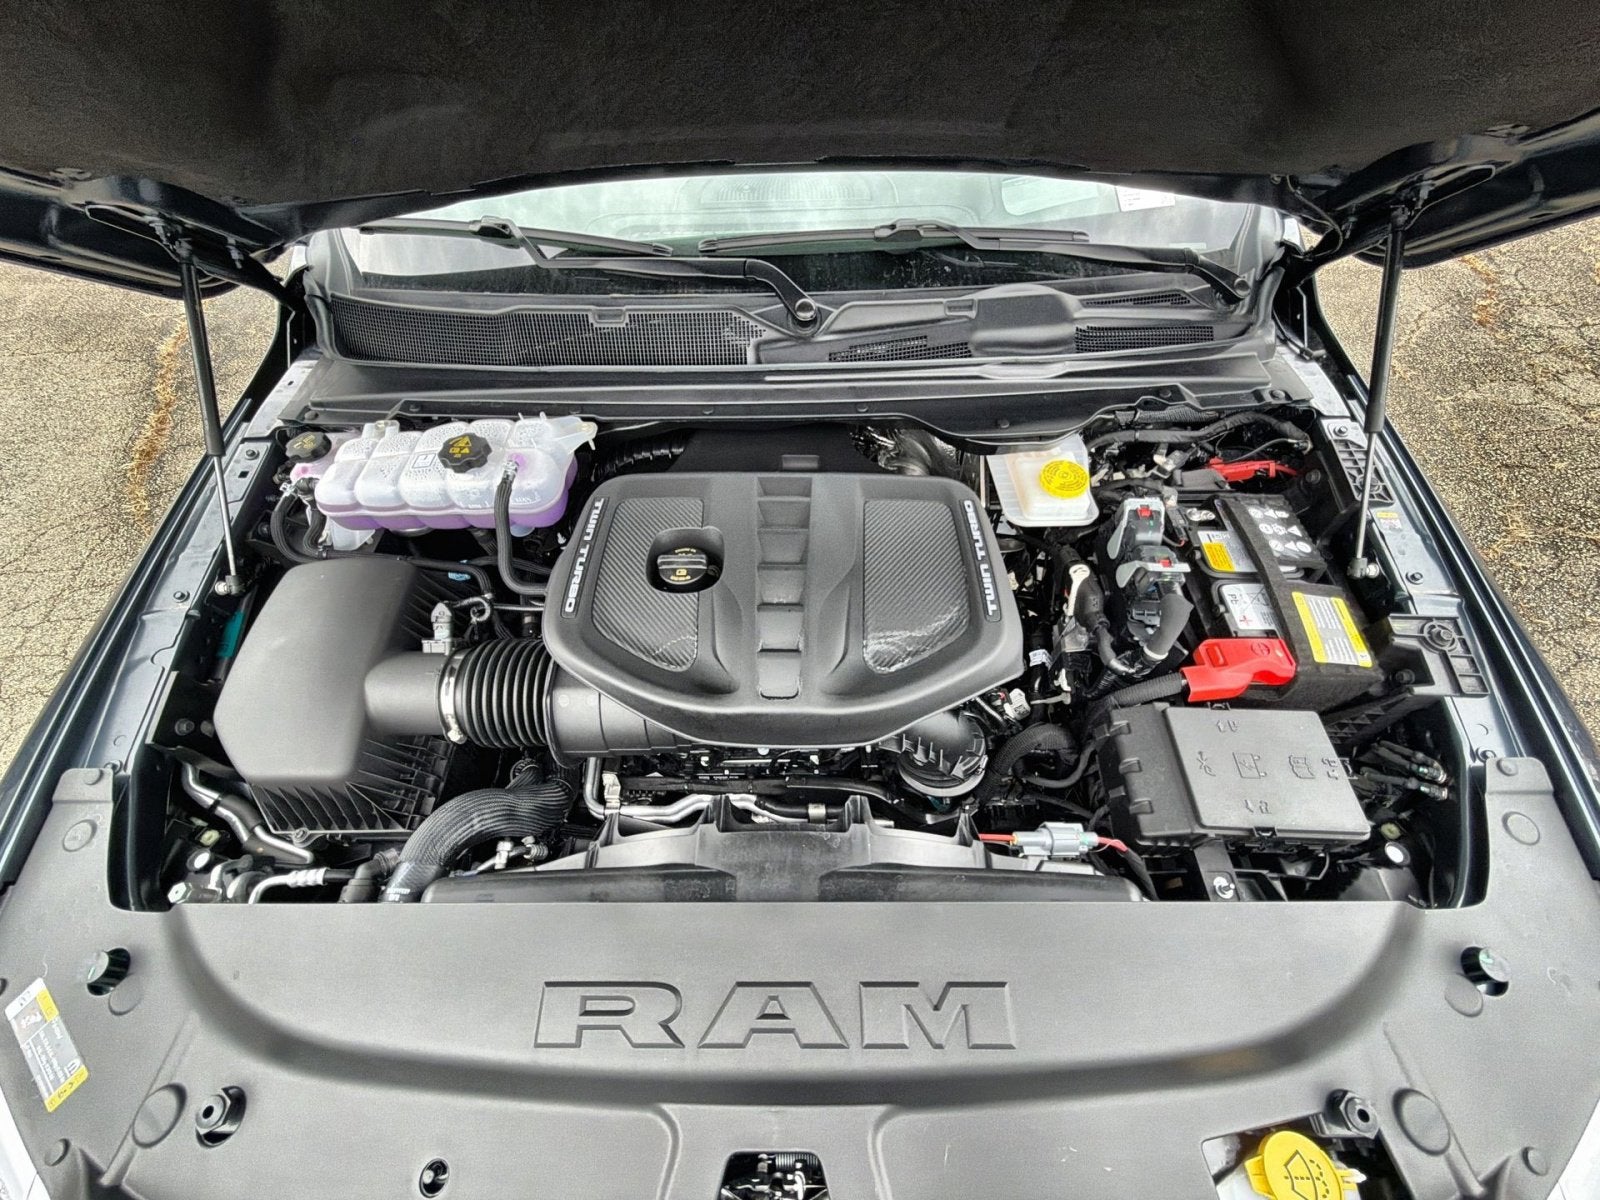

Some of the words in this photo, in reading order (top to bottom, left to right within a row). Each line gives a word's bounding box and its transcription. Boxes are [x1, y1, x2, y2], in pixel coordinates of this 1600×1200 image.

[583, 498, 605, 541] TWIN
[963, 500, 985, 561] TURBO
[565, 544, 588, 613] TURBO
[979, 564, 997, 616] TWIN
[533, 980, 1017, 1050] RAM
